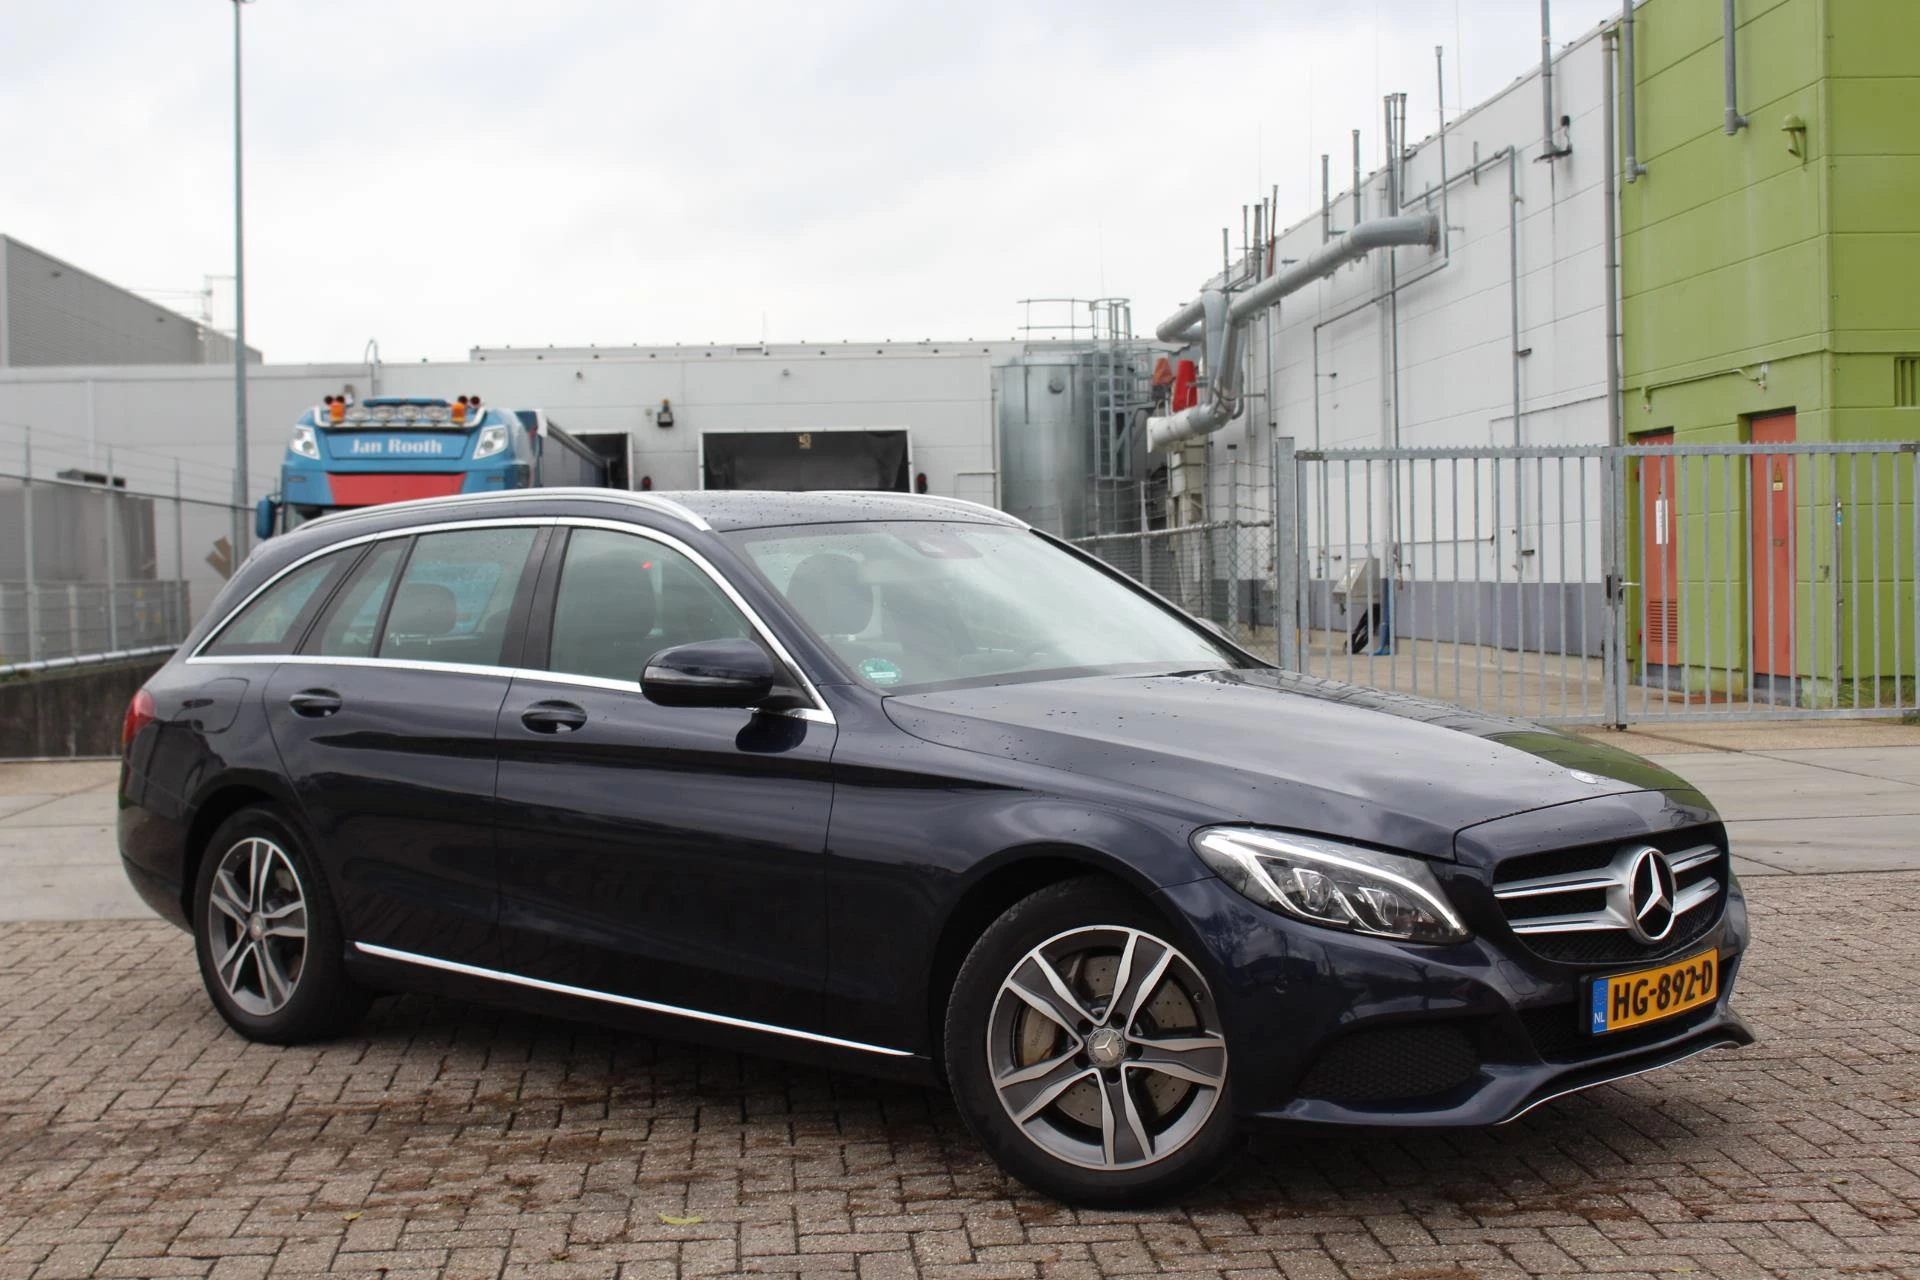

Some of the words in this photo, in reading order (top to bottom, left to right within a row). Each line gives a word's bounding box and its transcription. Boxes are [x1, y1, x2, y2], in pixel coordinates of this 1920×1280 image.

[351, 438, 383, 454] Jan
[1612, 959, 1713, 1022] HG-892-D
[1593, 1011, 1606, 1024] NL
